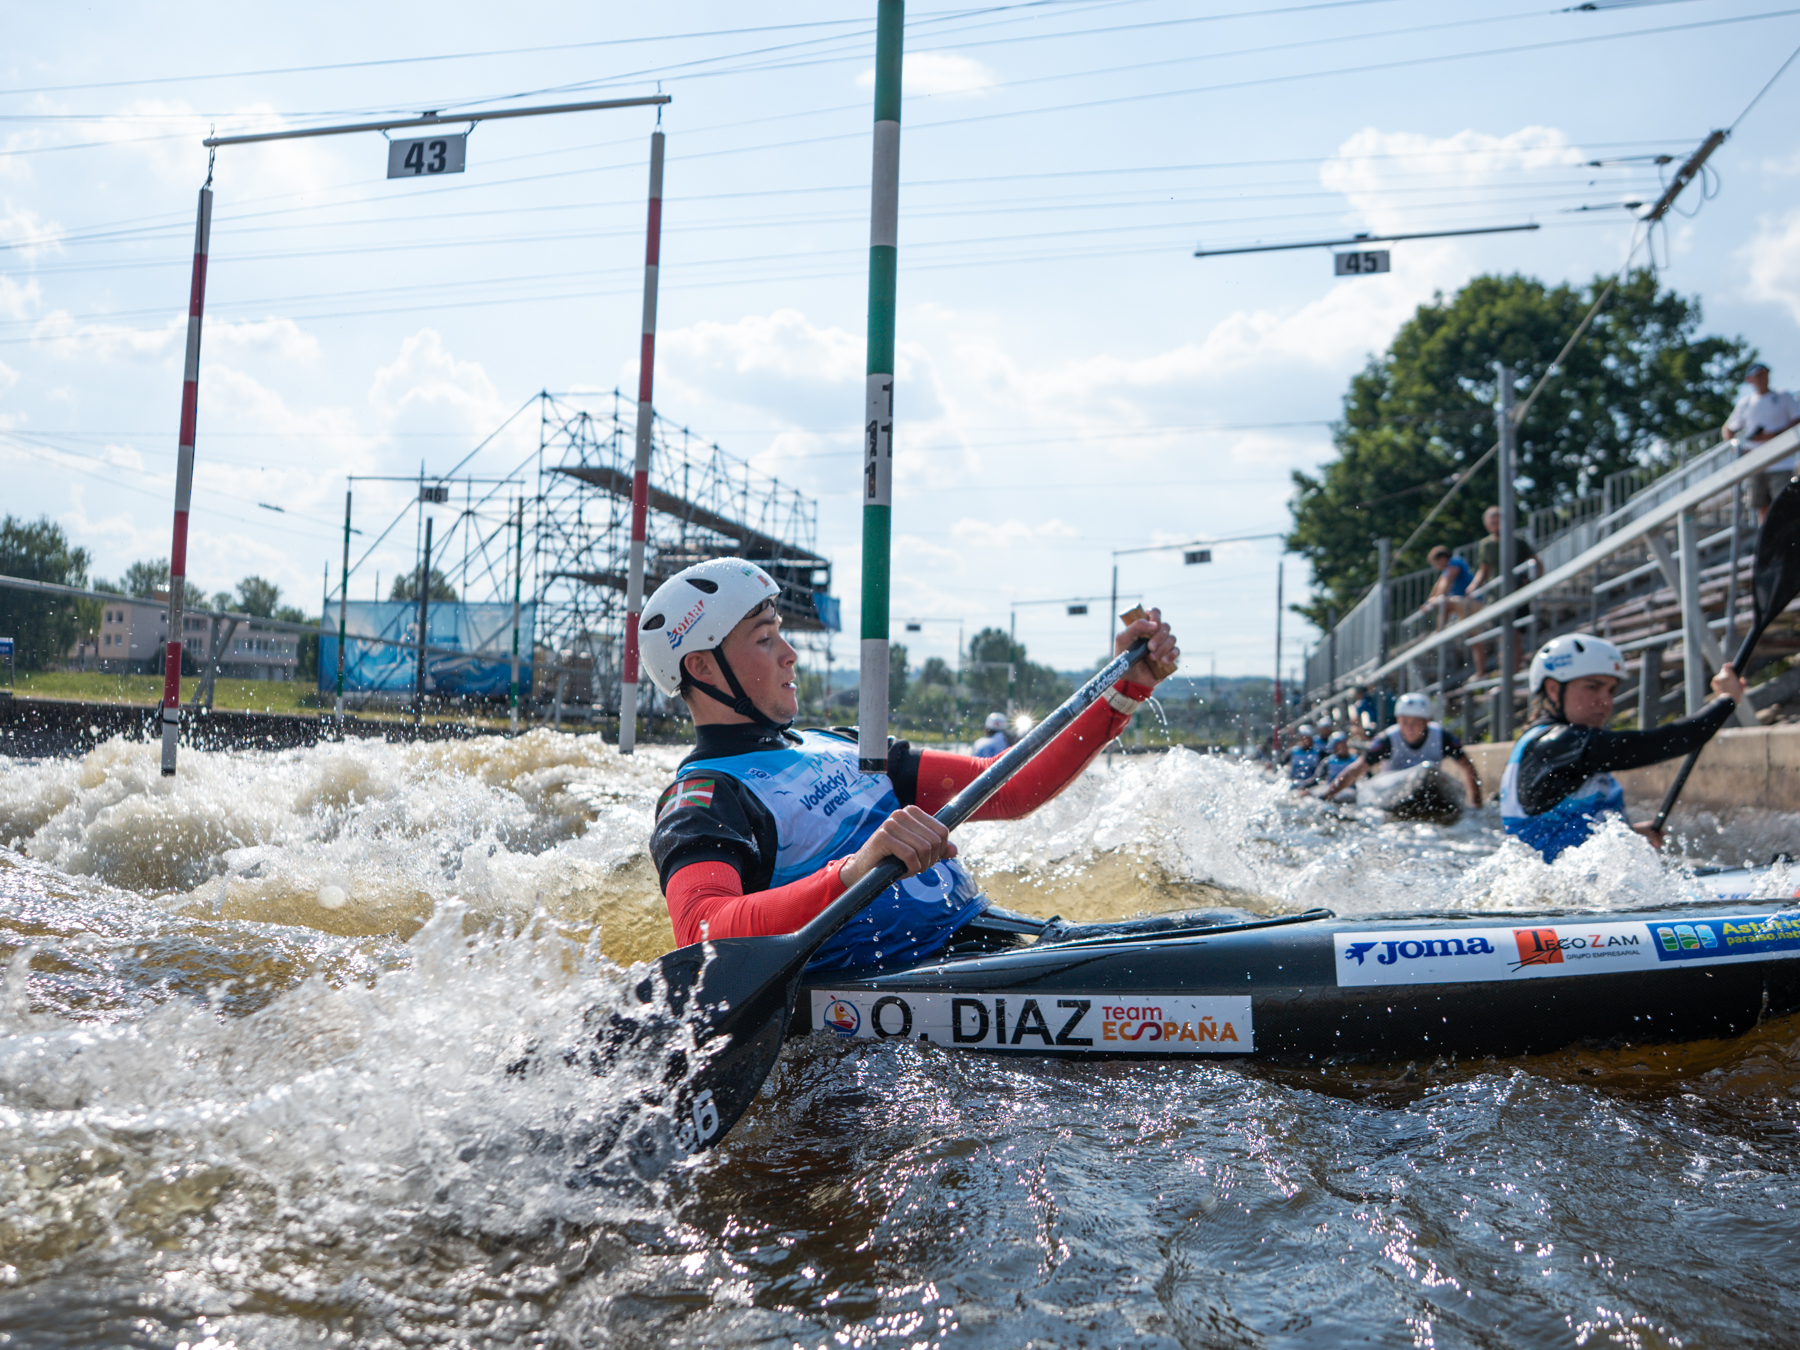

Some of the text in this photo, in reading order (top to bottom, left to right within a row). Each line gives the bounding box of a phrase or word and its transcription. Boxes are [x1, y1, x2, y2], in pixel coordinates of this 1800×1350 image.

[404, 140, 447, 174] 43
[1346, 252, 1377, 273] 45
[425, 488, 442, 503] 46
[799, 769, 848, 811] Vodácký
[823, 786, 852, 817] areál
[1566, 949, 1641, 960] GRUPO EMPRESARIAL
[871, 996, 1093, 1047] O. DIAZ
